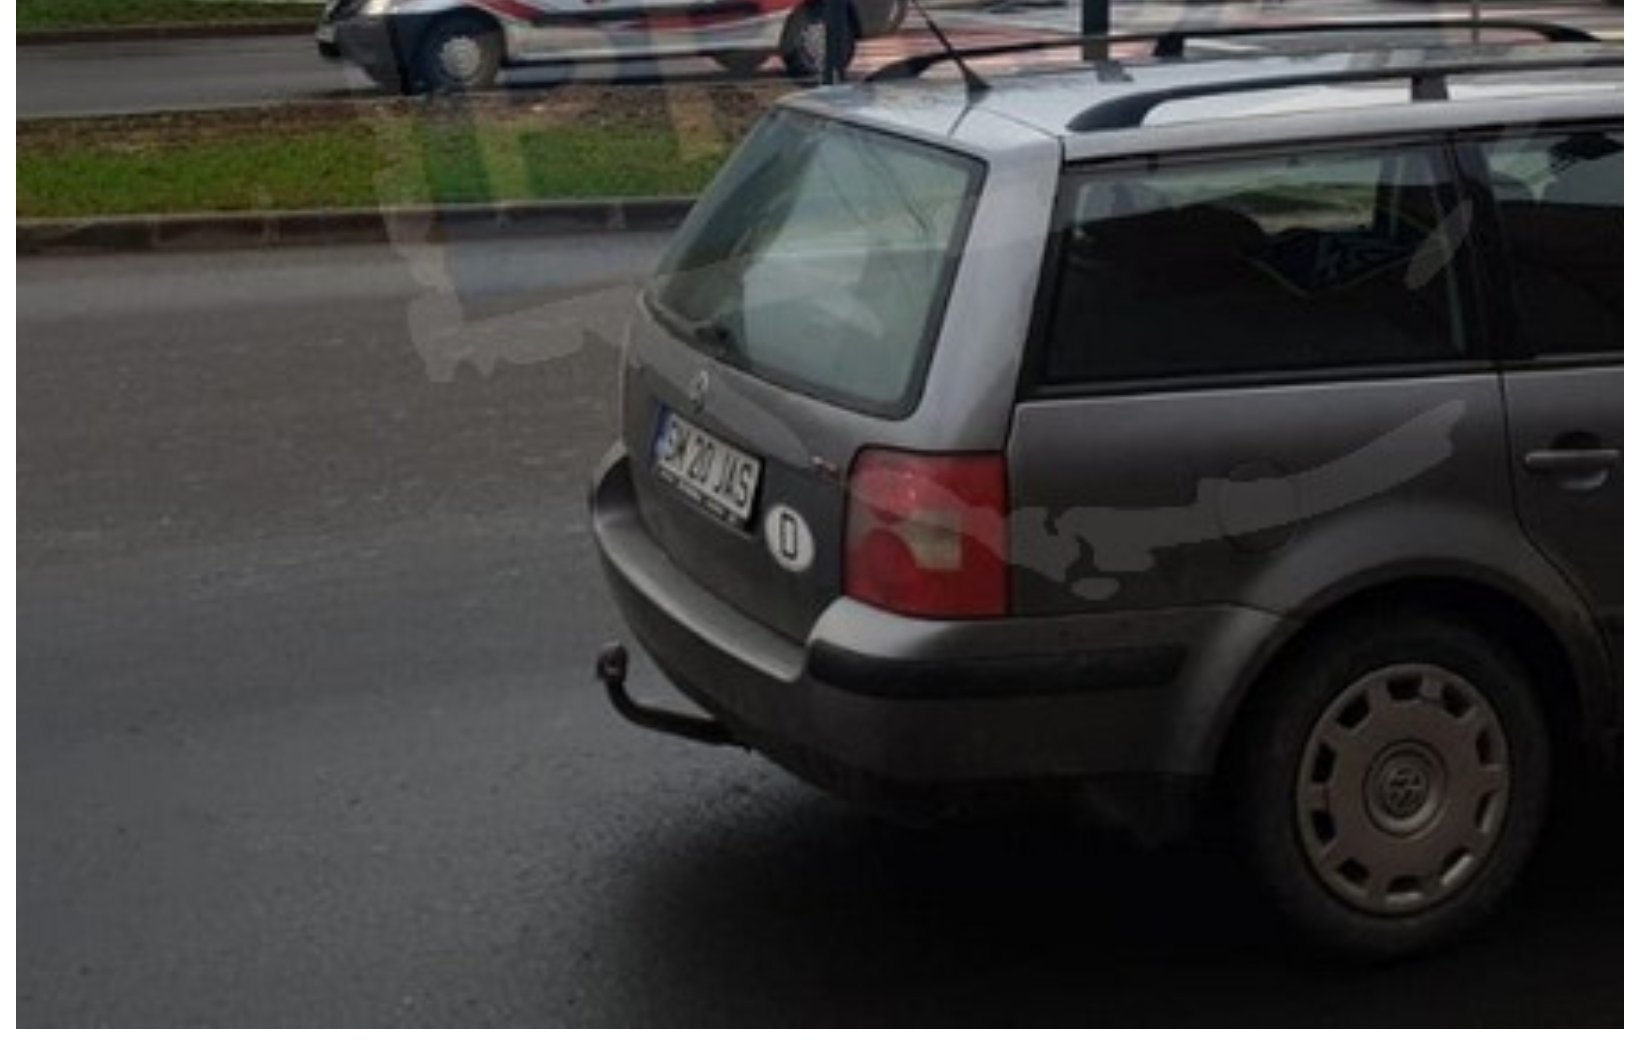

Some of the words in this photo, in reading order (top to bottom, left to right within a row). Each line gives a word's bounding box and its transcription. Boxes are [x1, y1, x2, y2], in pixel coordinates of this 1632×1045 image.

[664, 420, 691, 468] SM
[688, 435, 715, 485] 20
[714, 452, 752, 509] JAS
